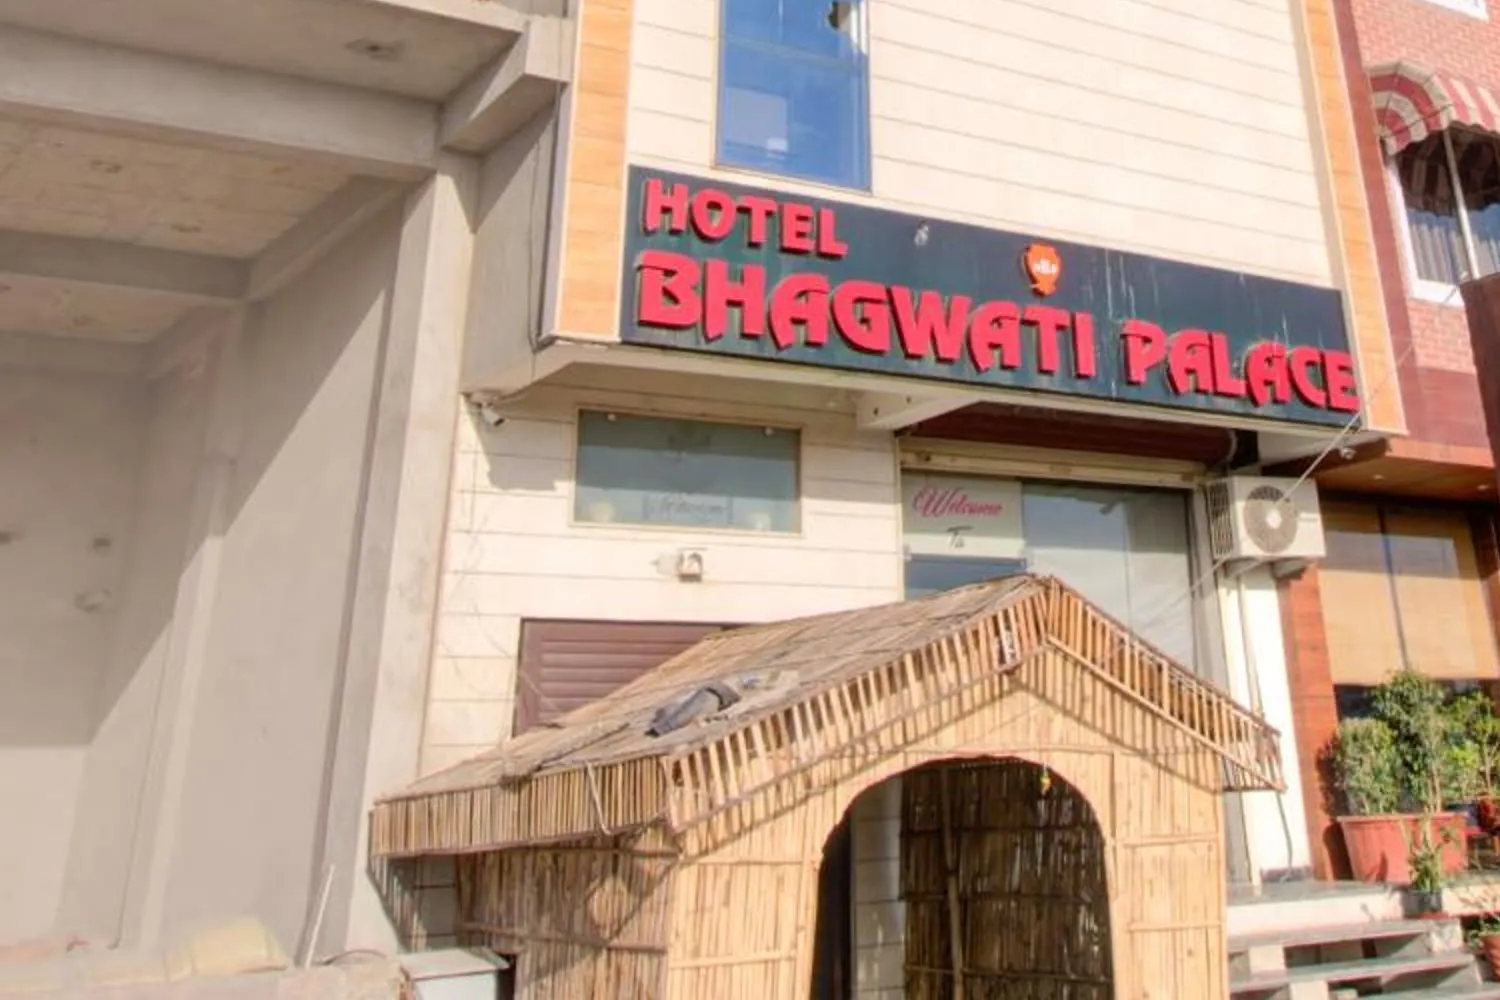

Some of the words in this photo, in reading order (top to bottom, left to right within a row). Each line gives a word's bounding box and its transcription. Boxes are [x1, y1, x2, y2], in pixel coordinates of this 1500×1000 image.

[642, 177, 849, 260] HOTEL
[637, 249, 1096, 380] BHAGWATI
[1121, 318, 1361, 413] PALACE
